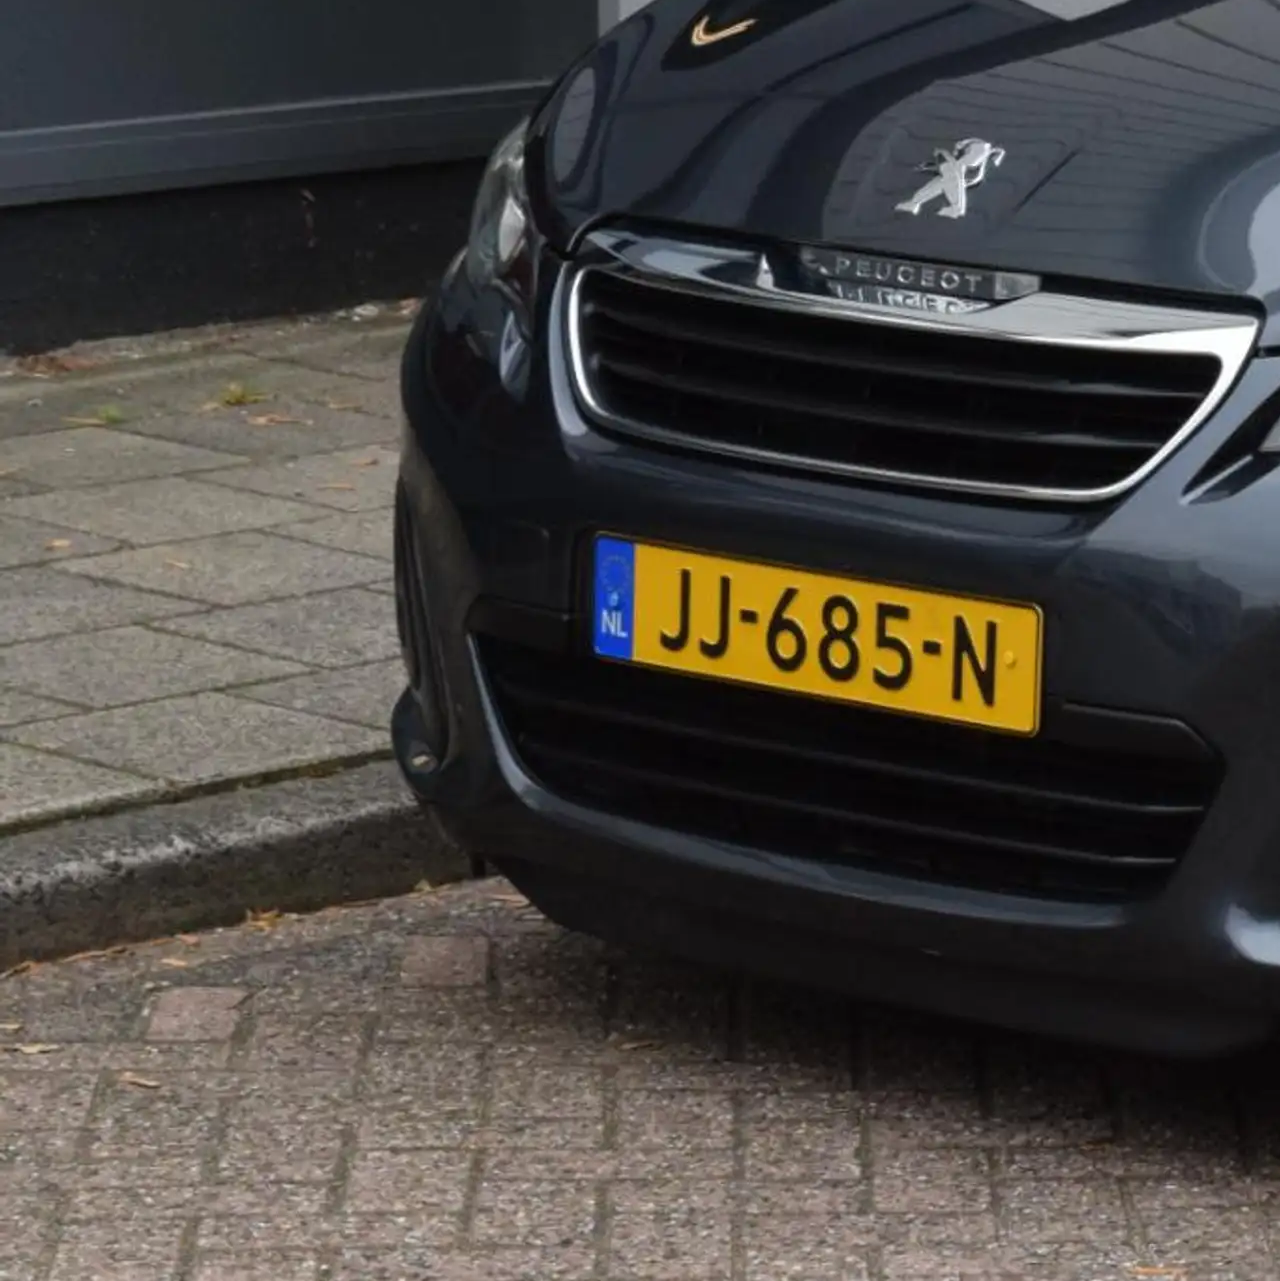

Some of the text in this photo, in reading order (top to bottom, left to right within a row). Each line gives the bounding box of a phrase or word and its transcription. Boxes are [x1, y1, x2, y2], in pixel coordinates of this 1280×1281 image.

[835, 255, 983, 294] PEUGEOT
[600, 609, 629, 640] NL
[659, 567, 999, 708] JJ-685-N
